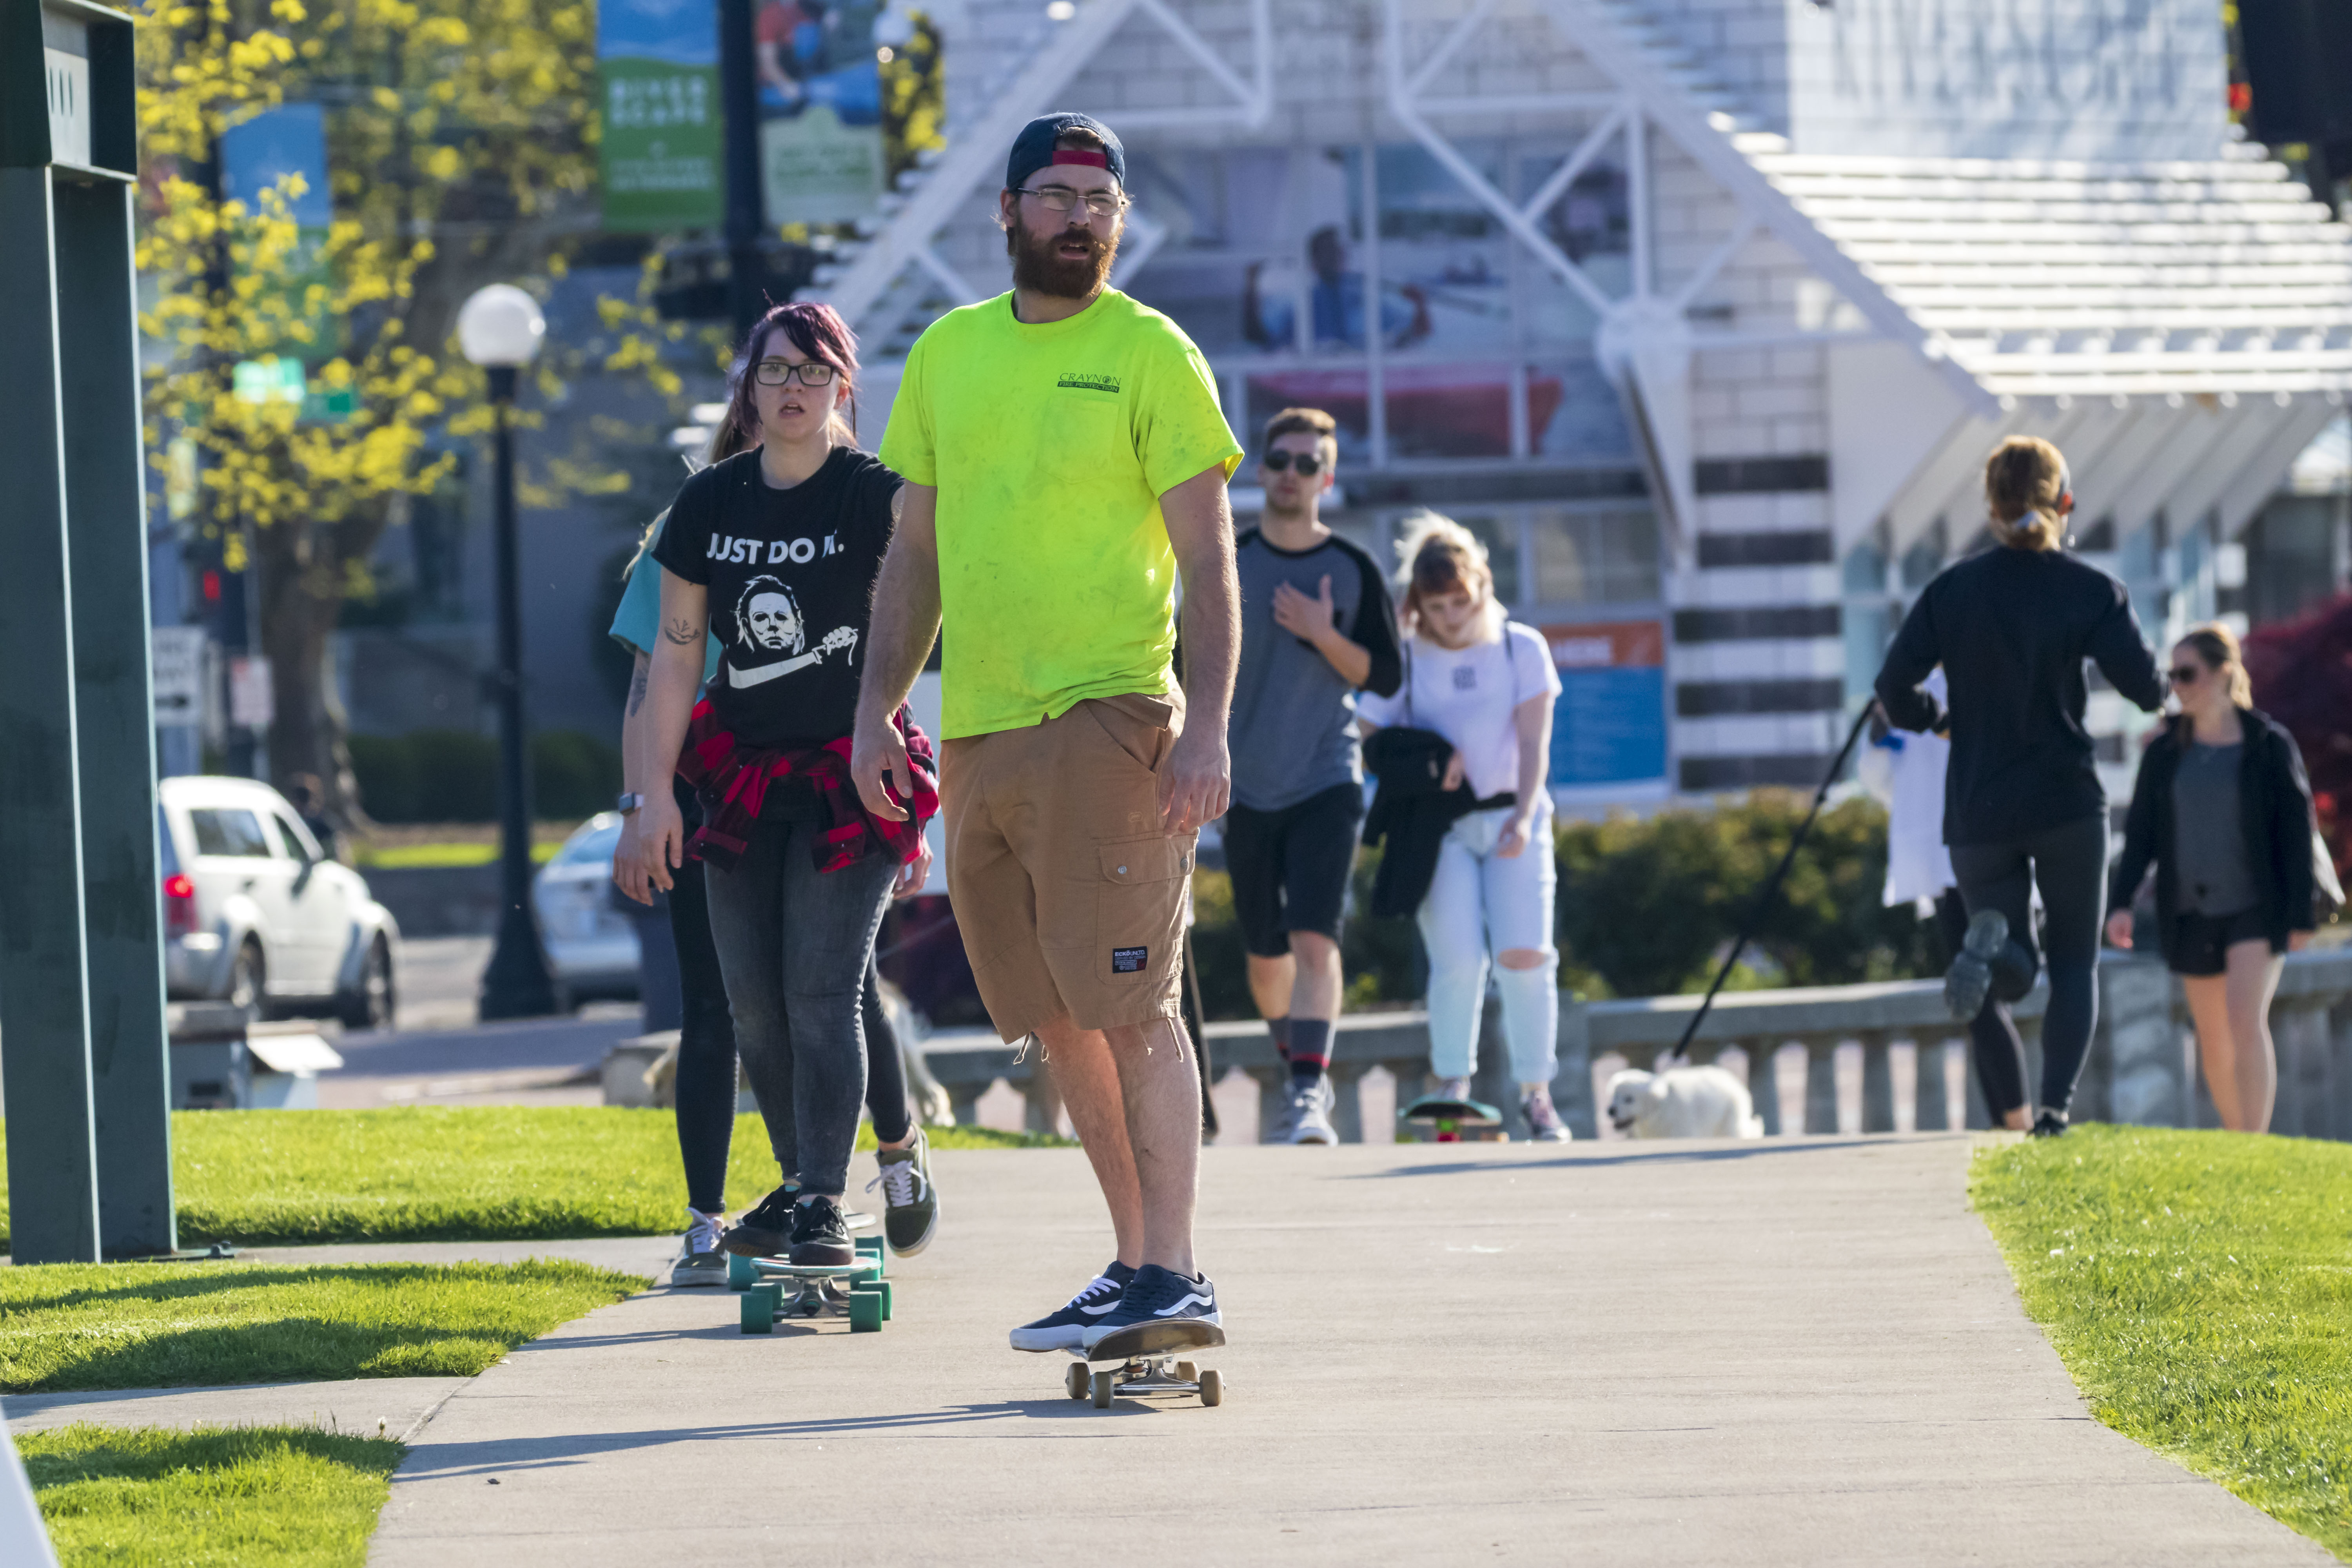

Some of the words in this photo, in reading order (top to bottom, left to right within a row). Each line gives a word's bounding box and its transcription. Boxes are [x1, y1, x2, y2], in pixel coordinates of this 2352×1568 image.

[1060, 373, 1122, 386] CRAYNON
[1075, 382, 1118, 392] PROTECTION
[706, 532, 763, 564] JUST
[767, 537, 815, 564] DO
